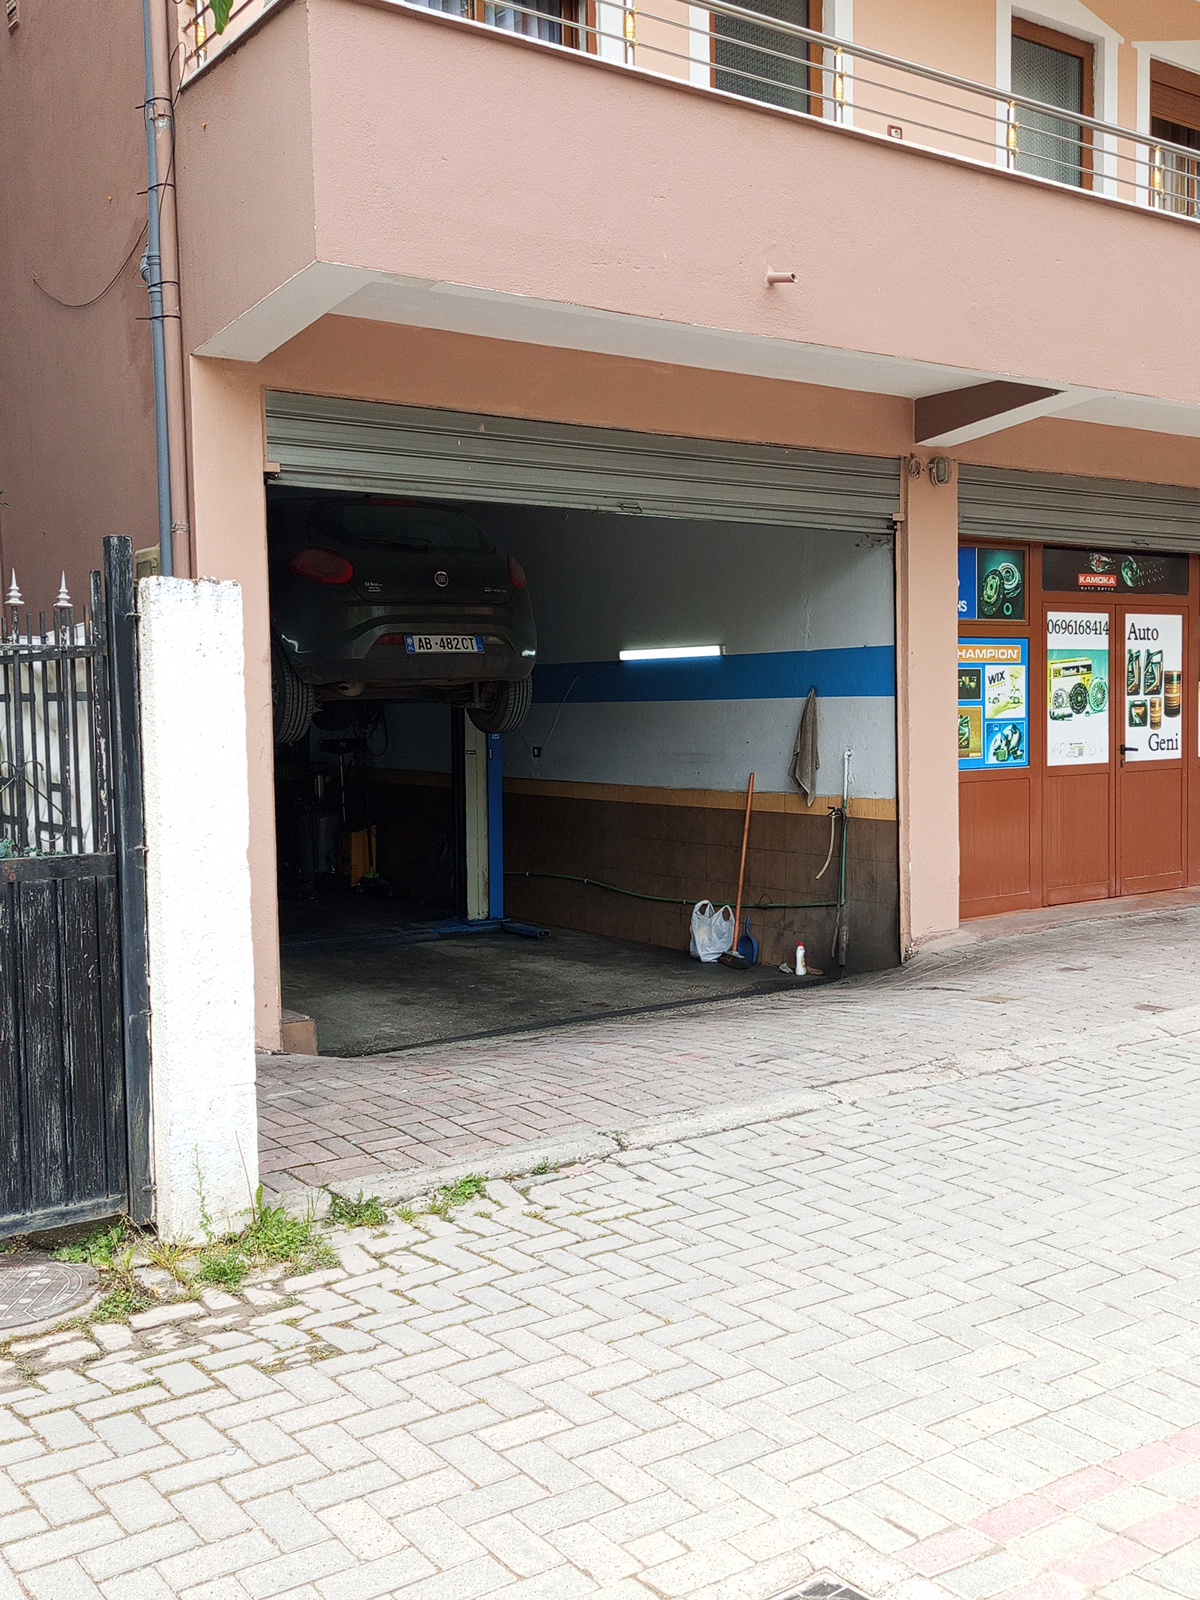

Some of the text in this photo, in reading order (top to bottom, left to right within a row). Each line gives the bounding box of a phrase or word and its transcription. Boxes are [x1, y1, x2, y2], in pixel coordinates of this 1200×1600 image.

[1079, 575, 1115, 584] KAMOKA
[1047, 619, 1109, 635] 0696168414
[1127, 622, 1159, 641] Auto
[987, 669, 1006, 685] WIX
[1148, 732, 1179, 752] Geni
